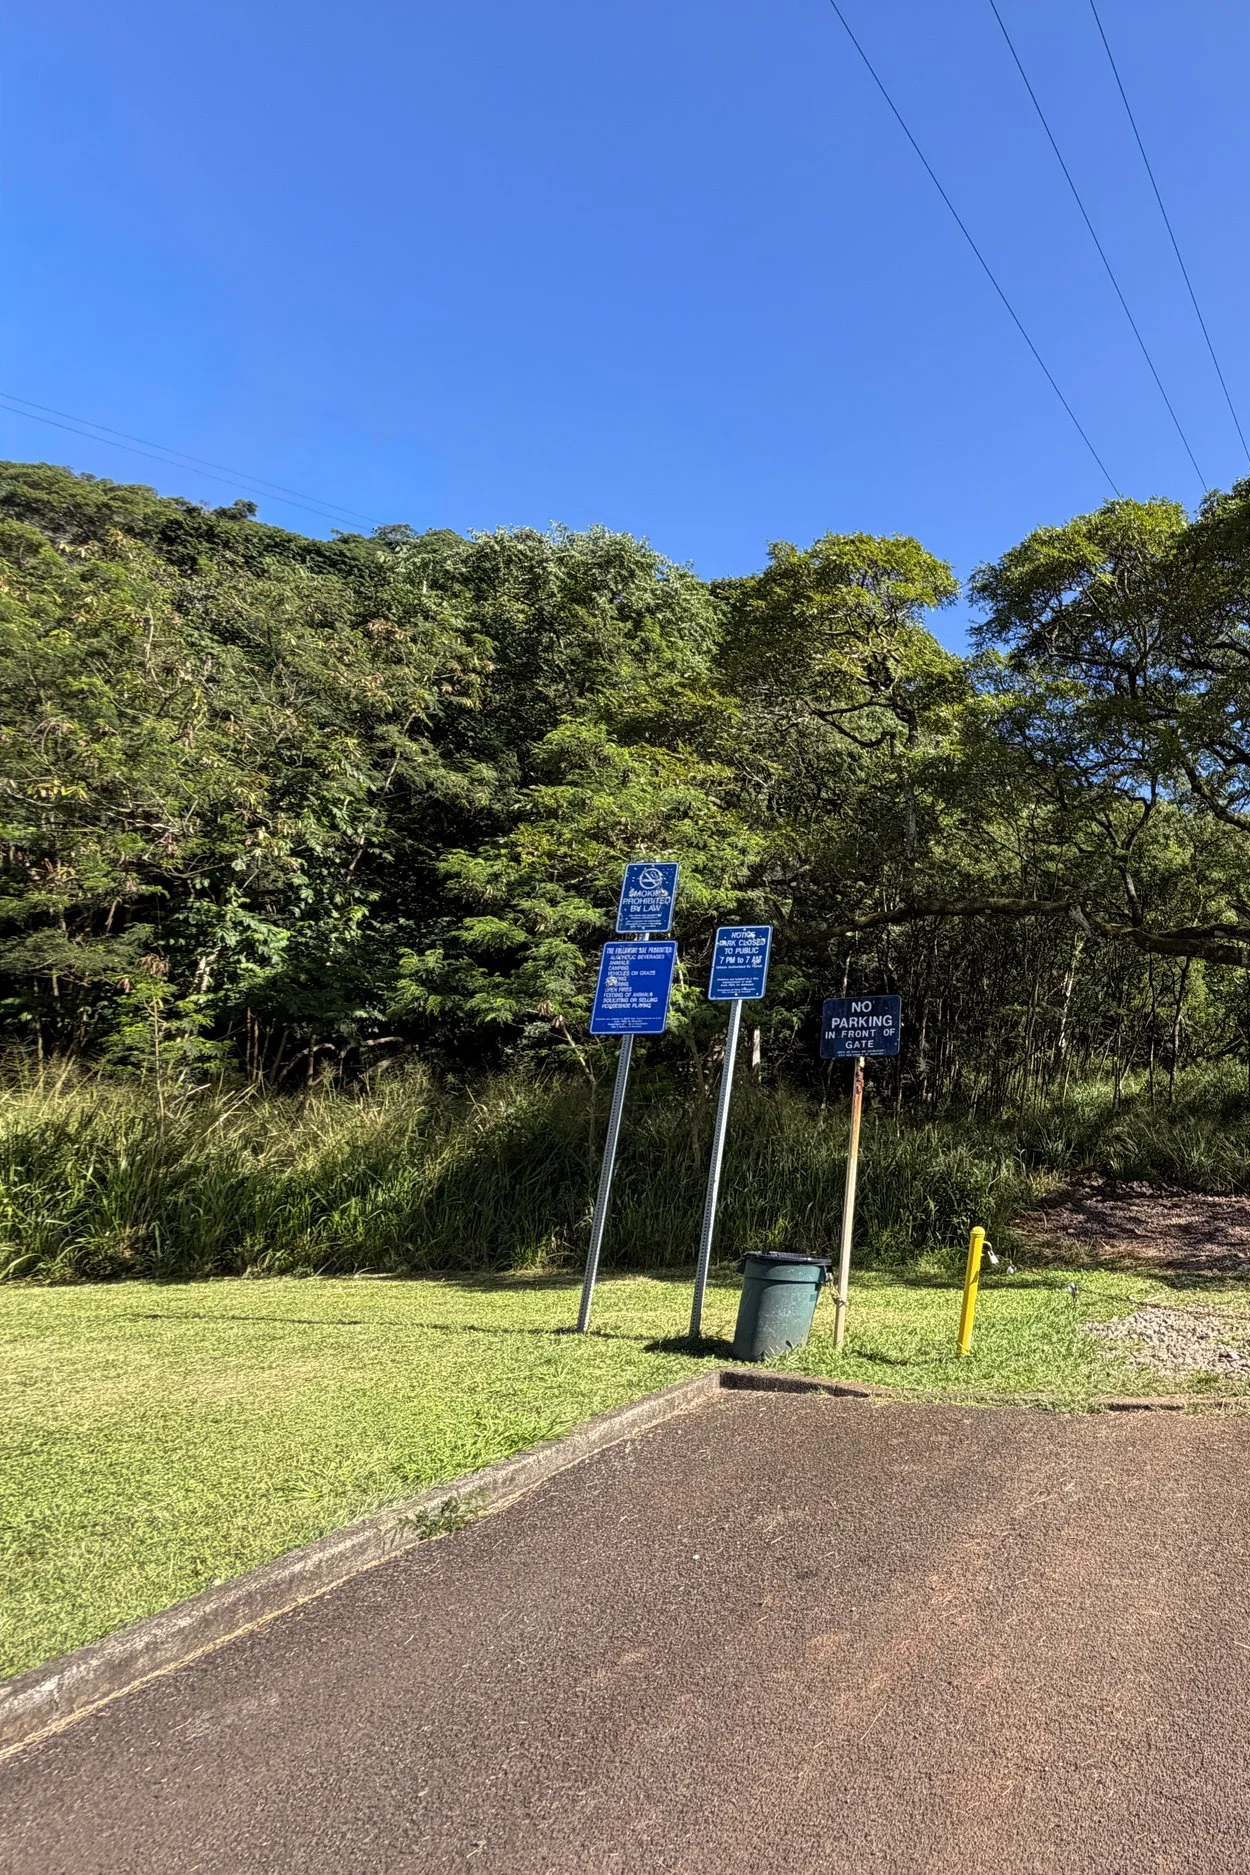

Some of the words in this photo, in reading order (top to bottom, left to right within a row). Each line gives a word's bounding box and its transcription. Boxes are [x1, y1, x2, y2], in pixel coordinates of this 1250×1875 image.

[852, 1001, 872, 1013] NO
[832, 1015, 892, 1029] PARKING
[825, 1031, 835, 1039] IN
[842, 1030, 876, 1038] FRONT
[846, 1040, 874, 1049] GATE
